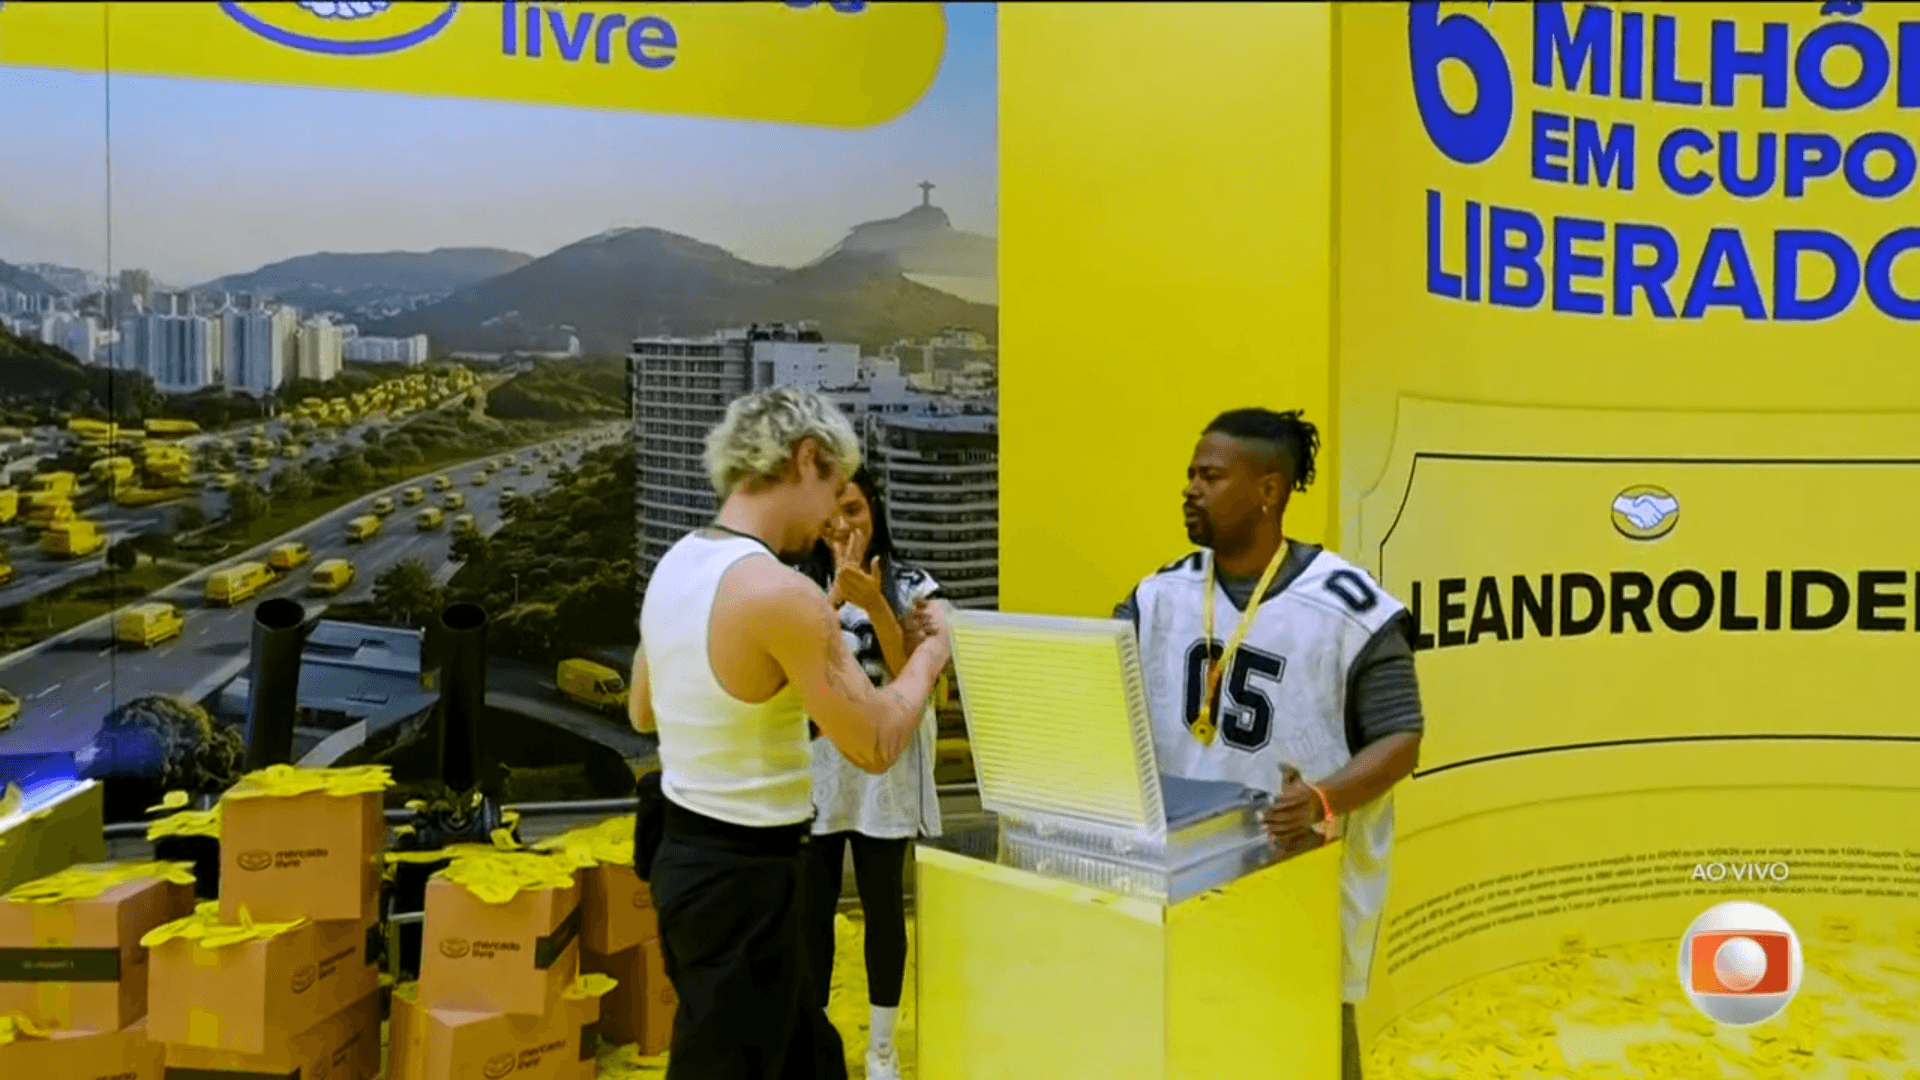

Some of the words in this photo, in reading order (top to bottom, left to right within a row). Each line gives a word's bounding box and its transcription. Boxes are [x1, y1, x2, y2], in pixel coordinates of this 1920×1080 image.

[501, 2, 678, 69] livre
[1408, 2, 1514, 164] 6
[1532, 110, 1635, 191] EM
[1411, 569, 1920, 652] LEANDROLIDE
